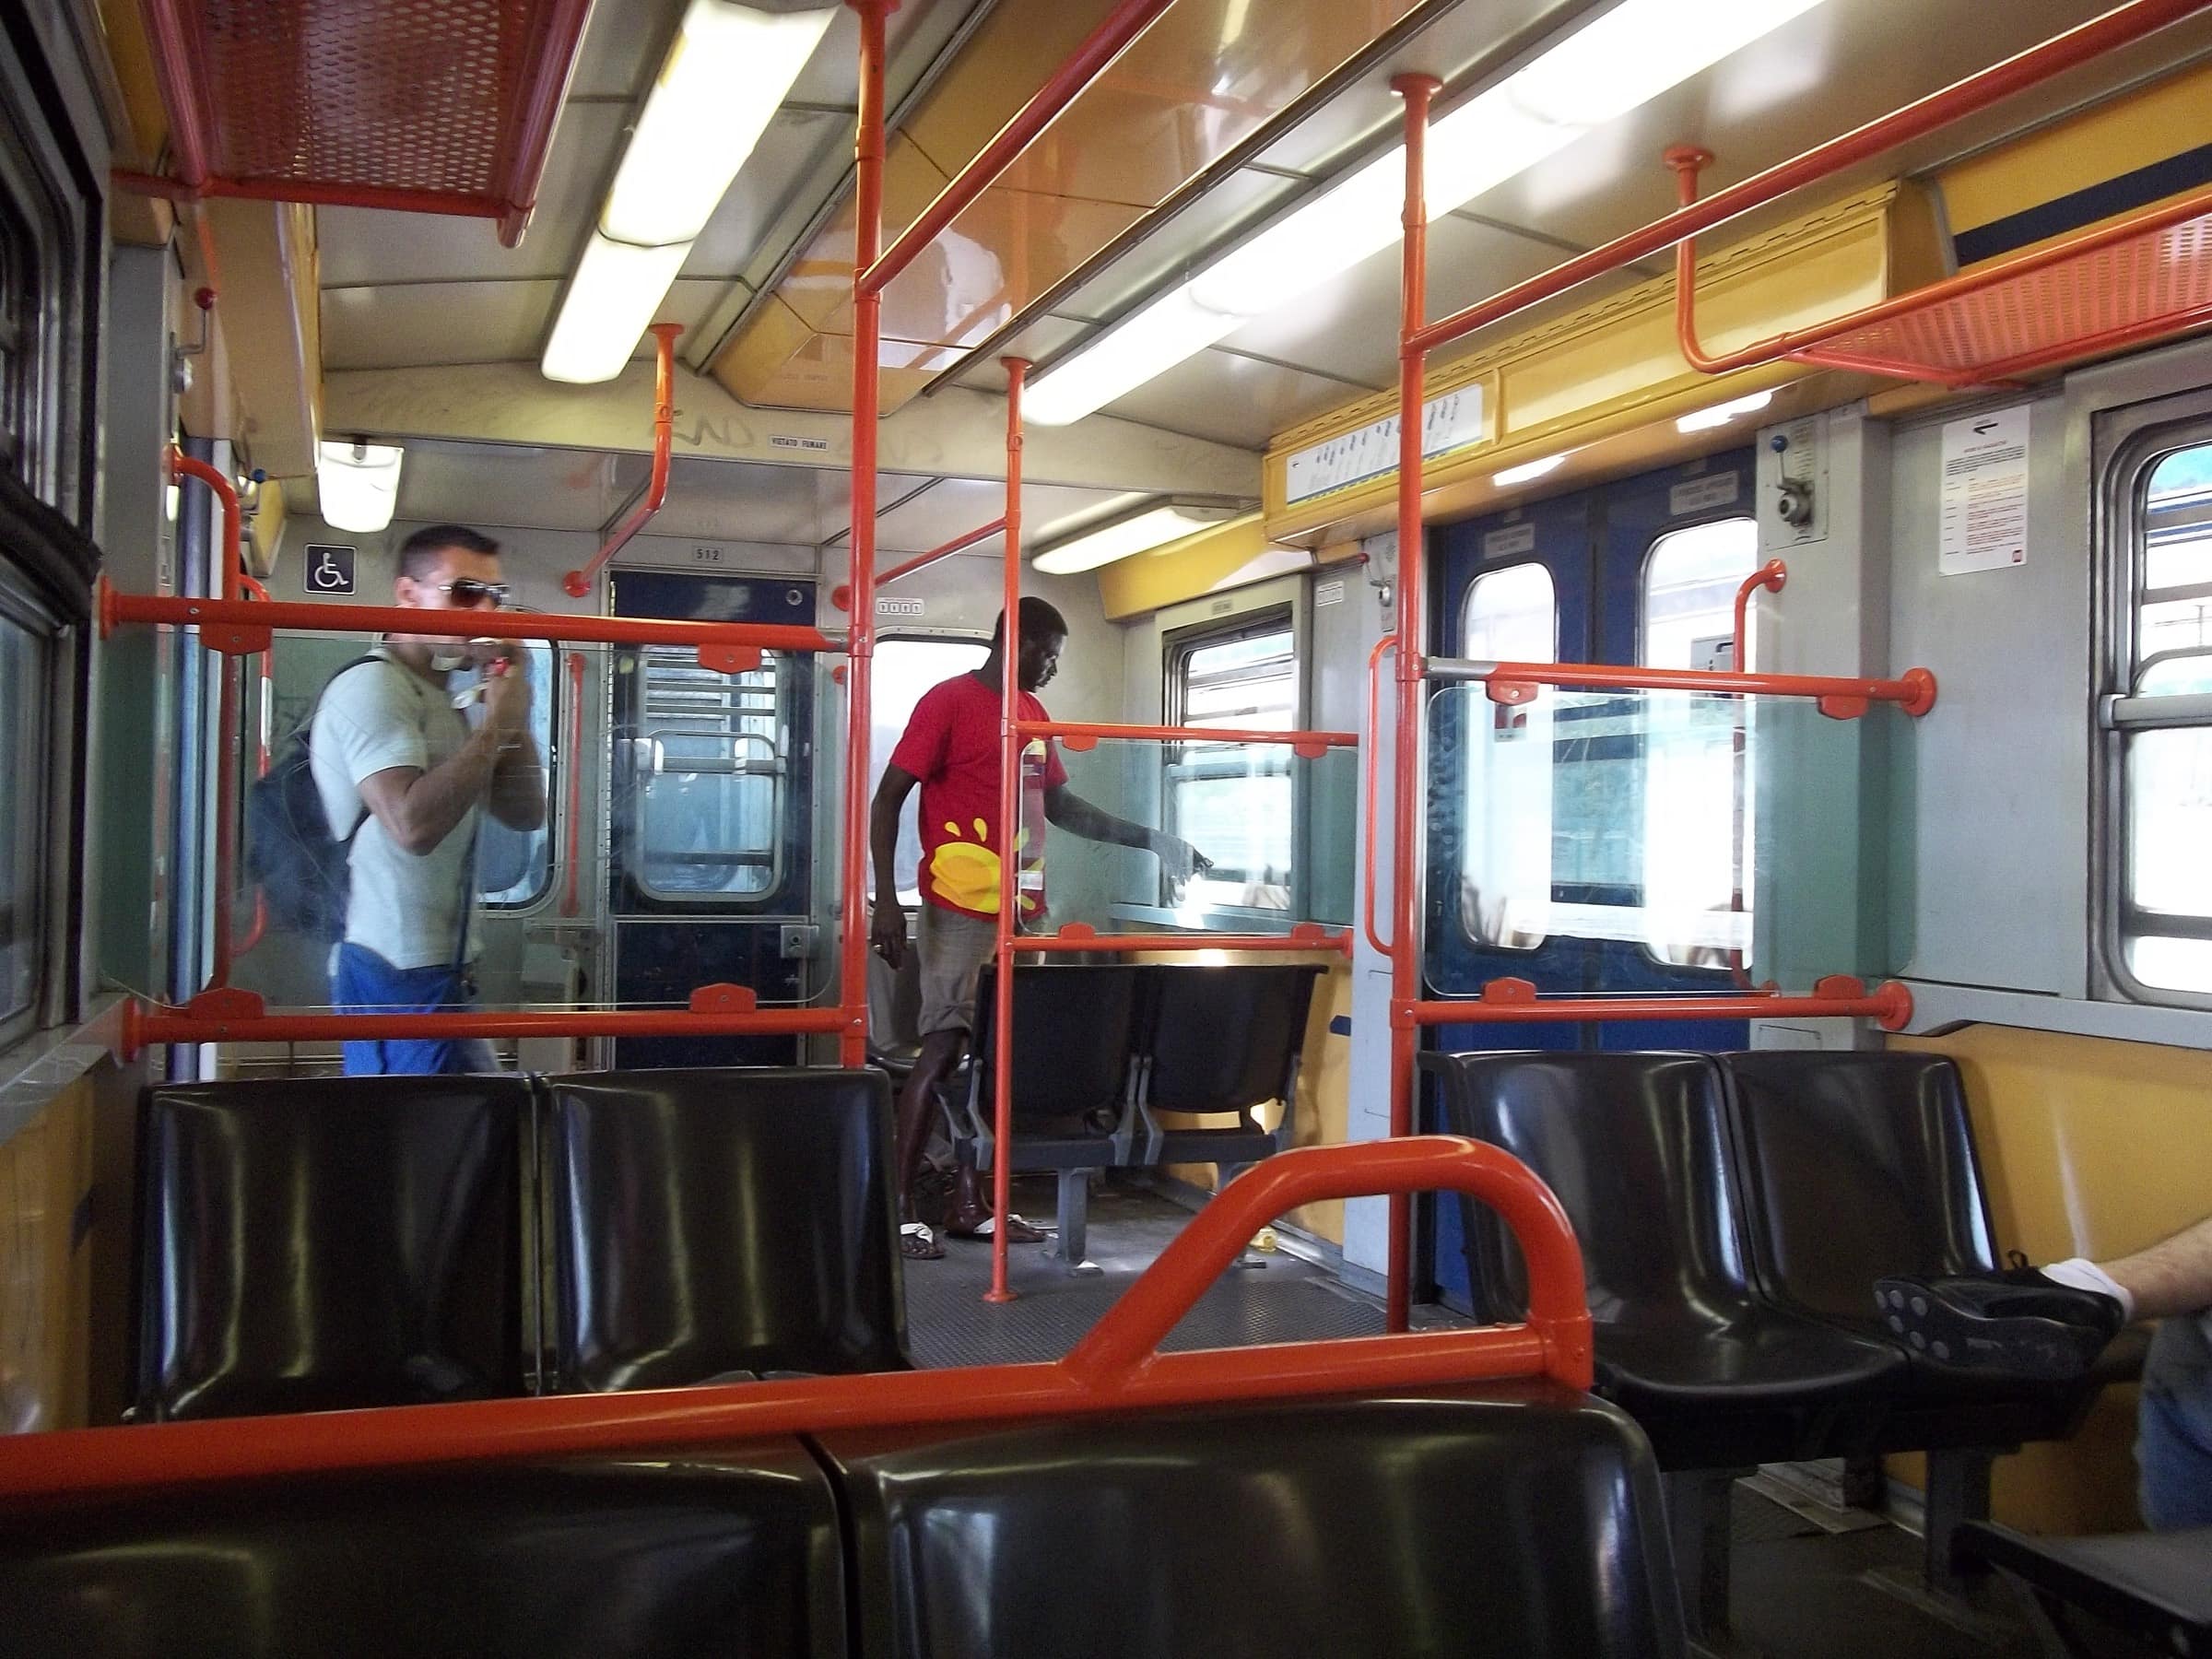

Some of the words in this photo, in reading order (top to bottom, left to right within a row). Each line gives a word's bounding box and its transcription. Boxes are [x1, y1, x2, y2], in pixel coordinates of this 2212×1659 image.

[771, 437, 797, 448] VIETATO
[802, 440, 827, 450] FUMARE
[696, 548, 719, 560] 512
